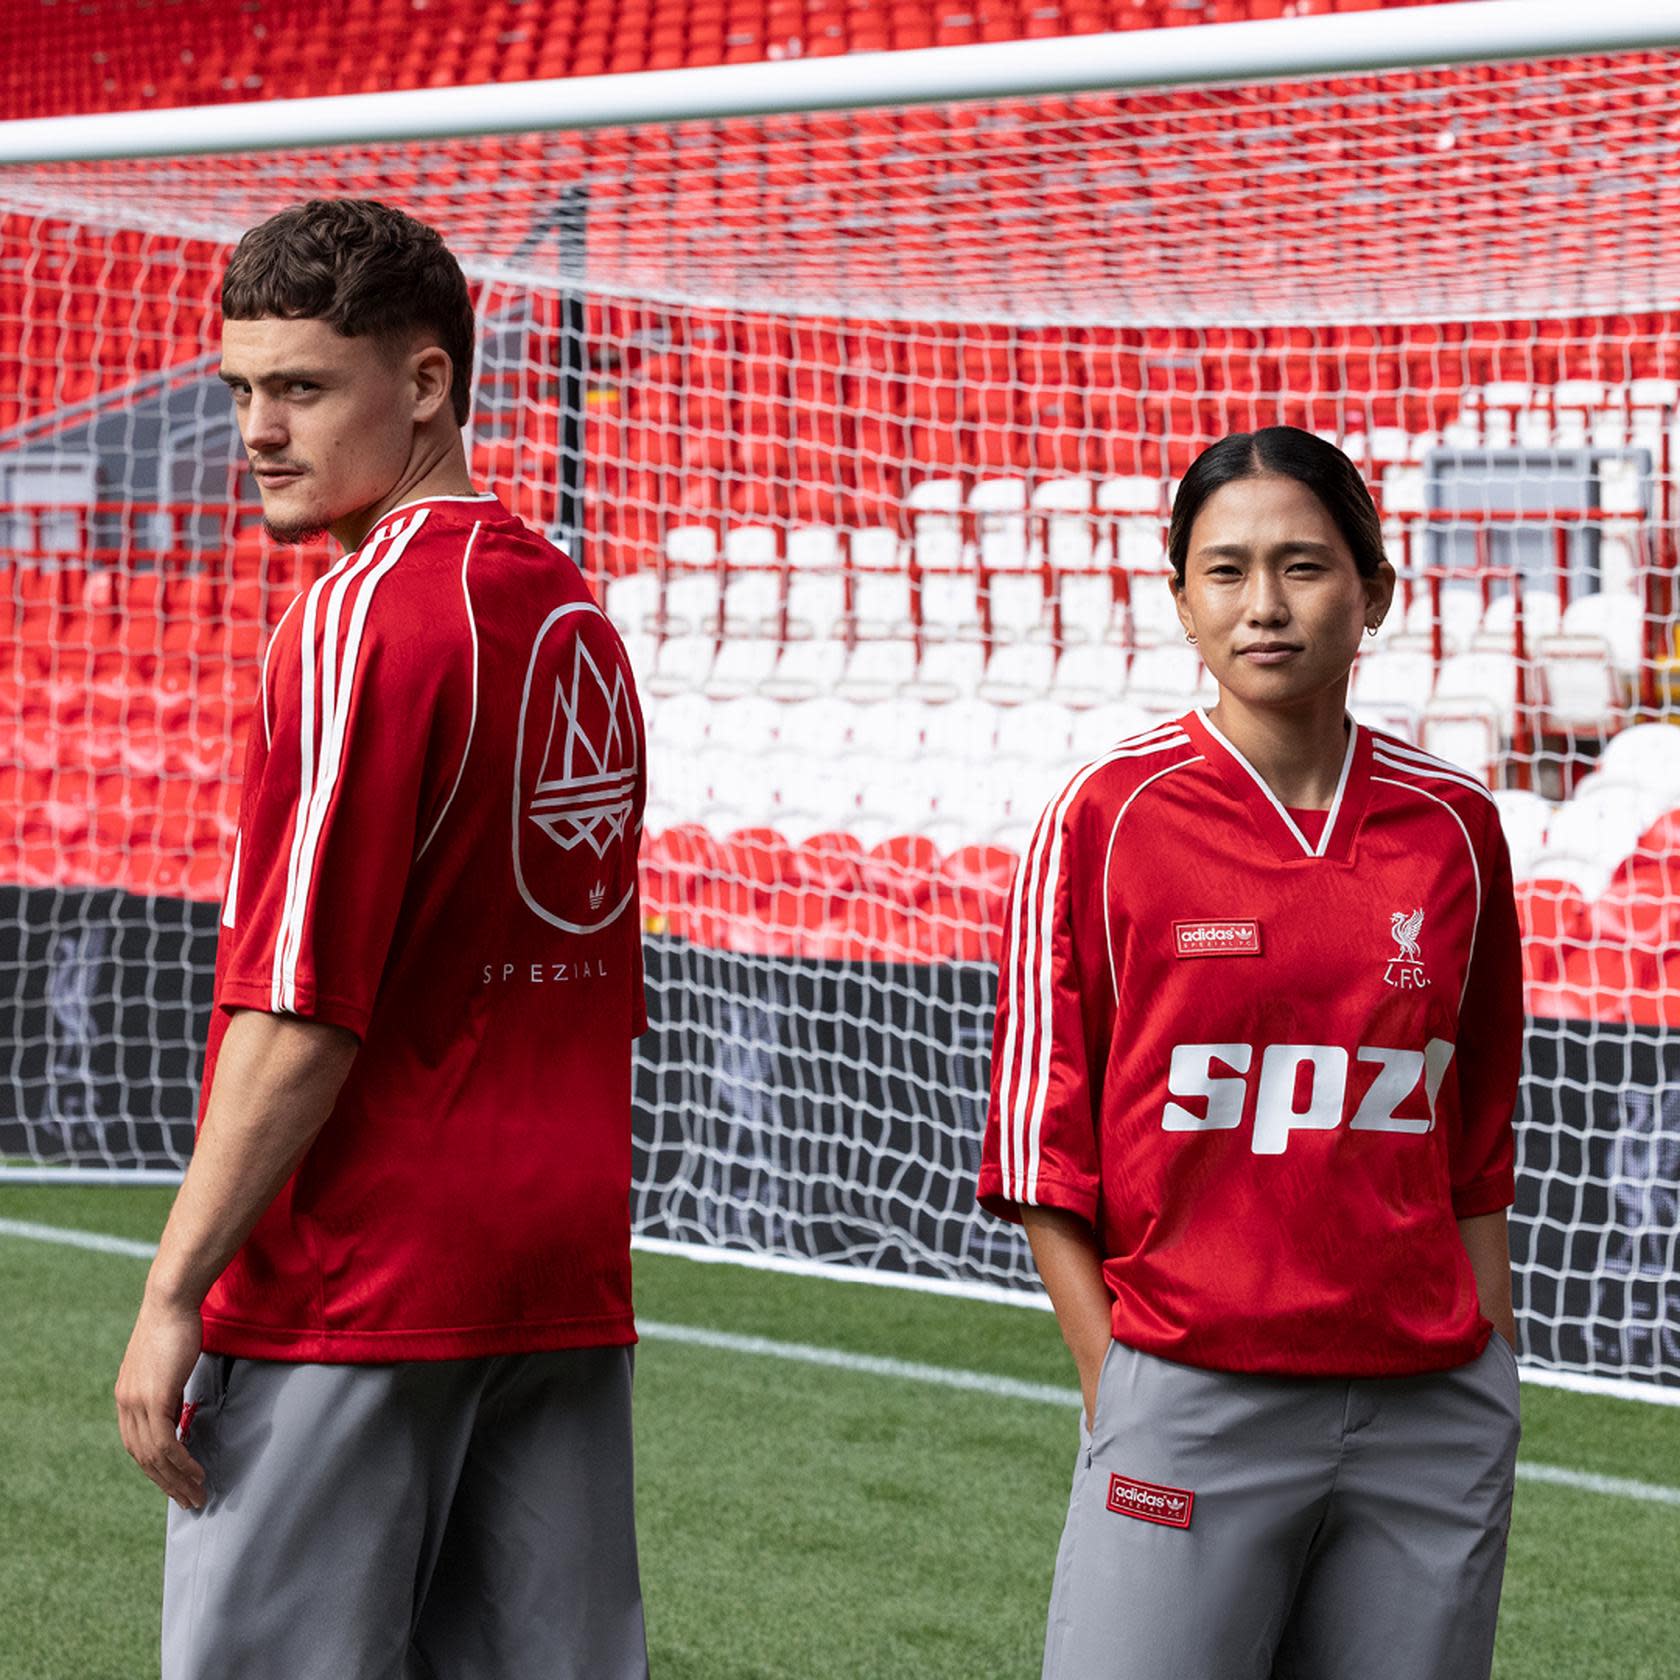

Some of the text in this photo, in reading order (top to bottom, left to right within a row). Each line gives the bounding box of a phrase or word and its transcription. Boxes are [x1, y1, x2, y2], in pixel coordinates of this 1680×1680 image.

[1181, 927, 1235, 942] adidas
[482, 959, 608, 984] SPEZIAL
[1115, 1486, 1165, 1508] adidas
